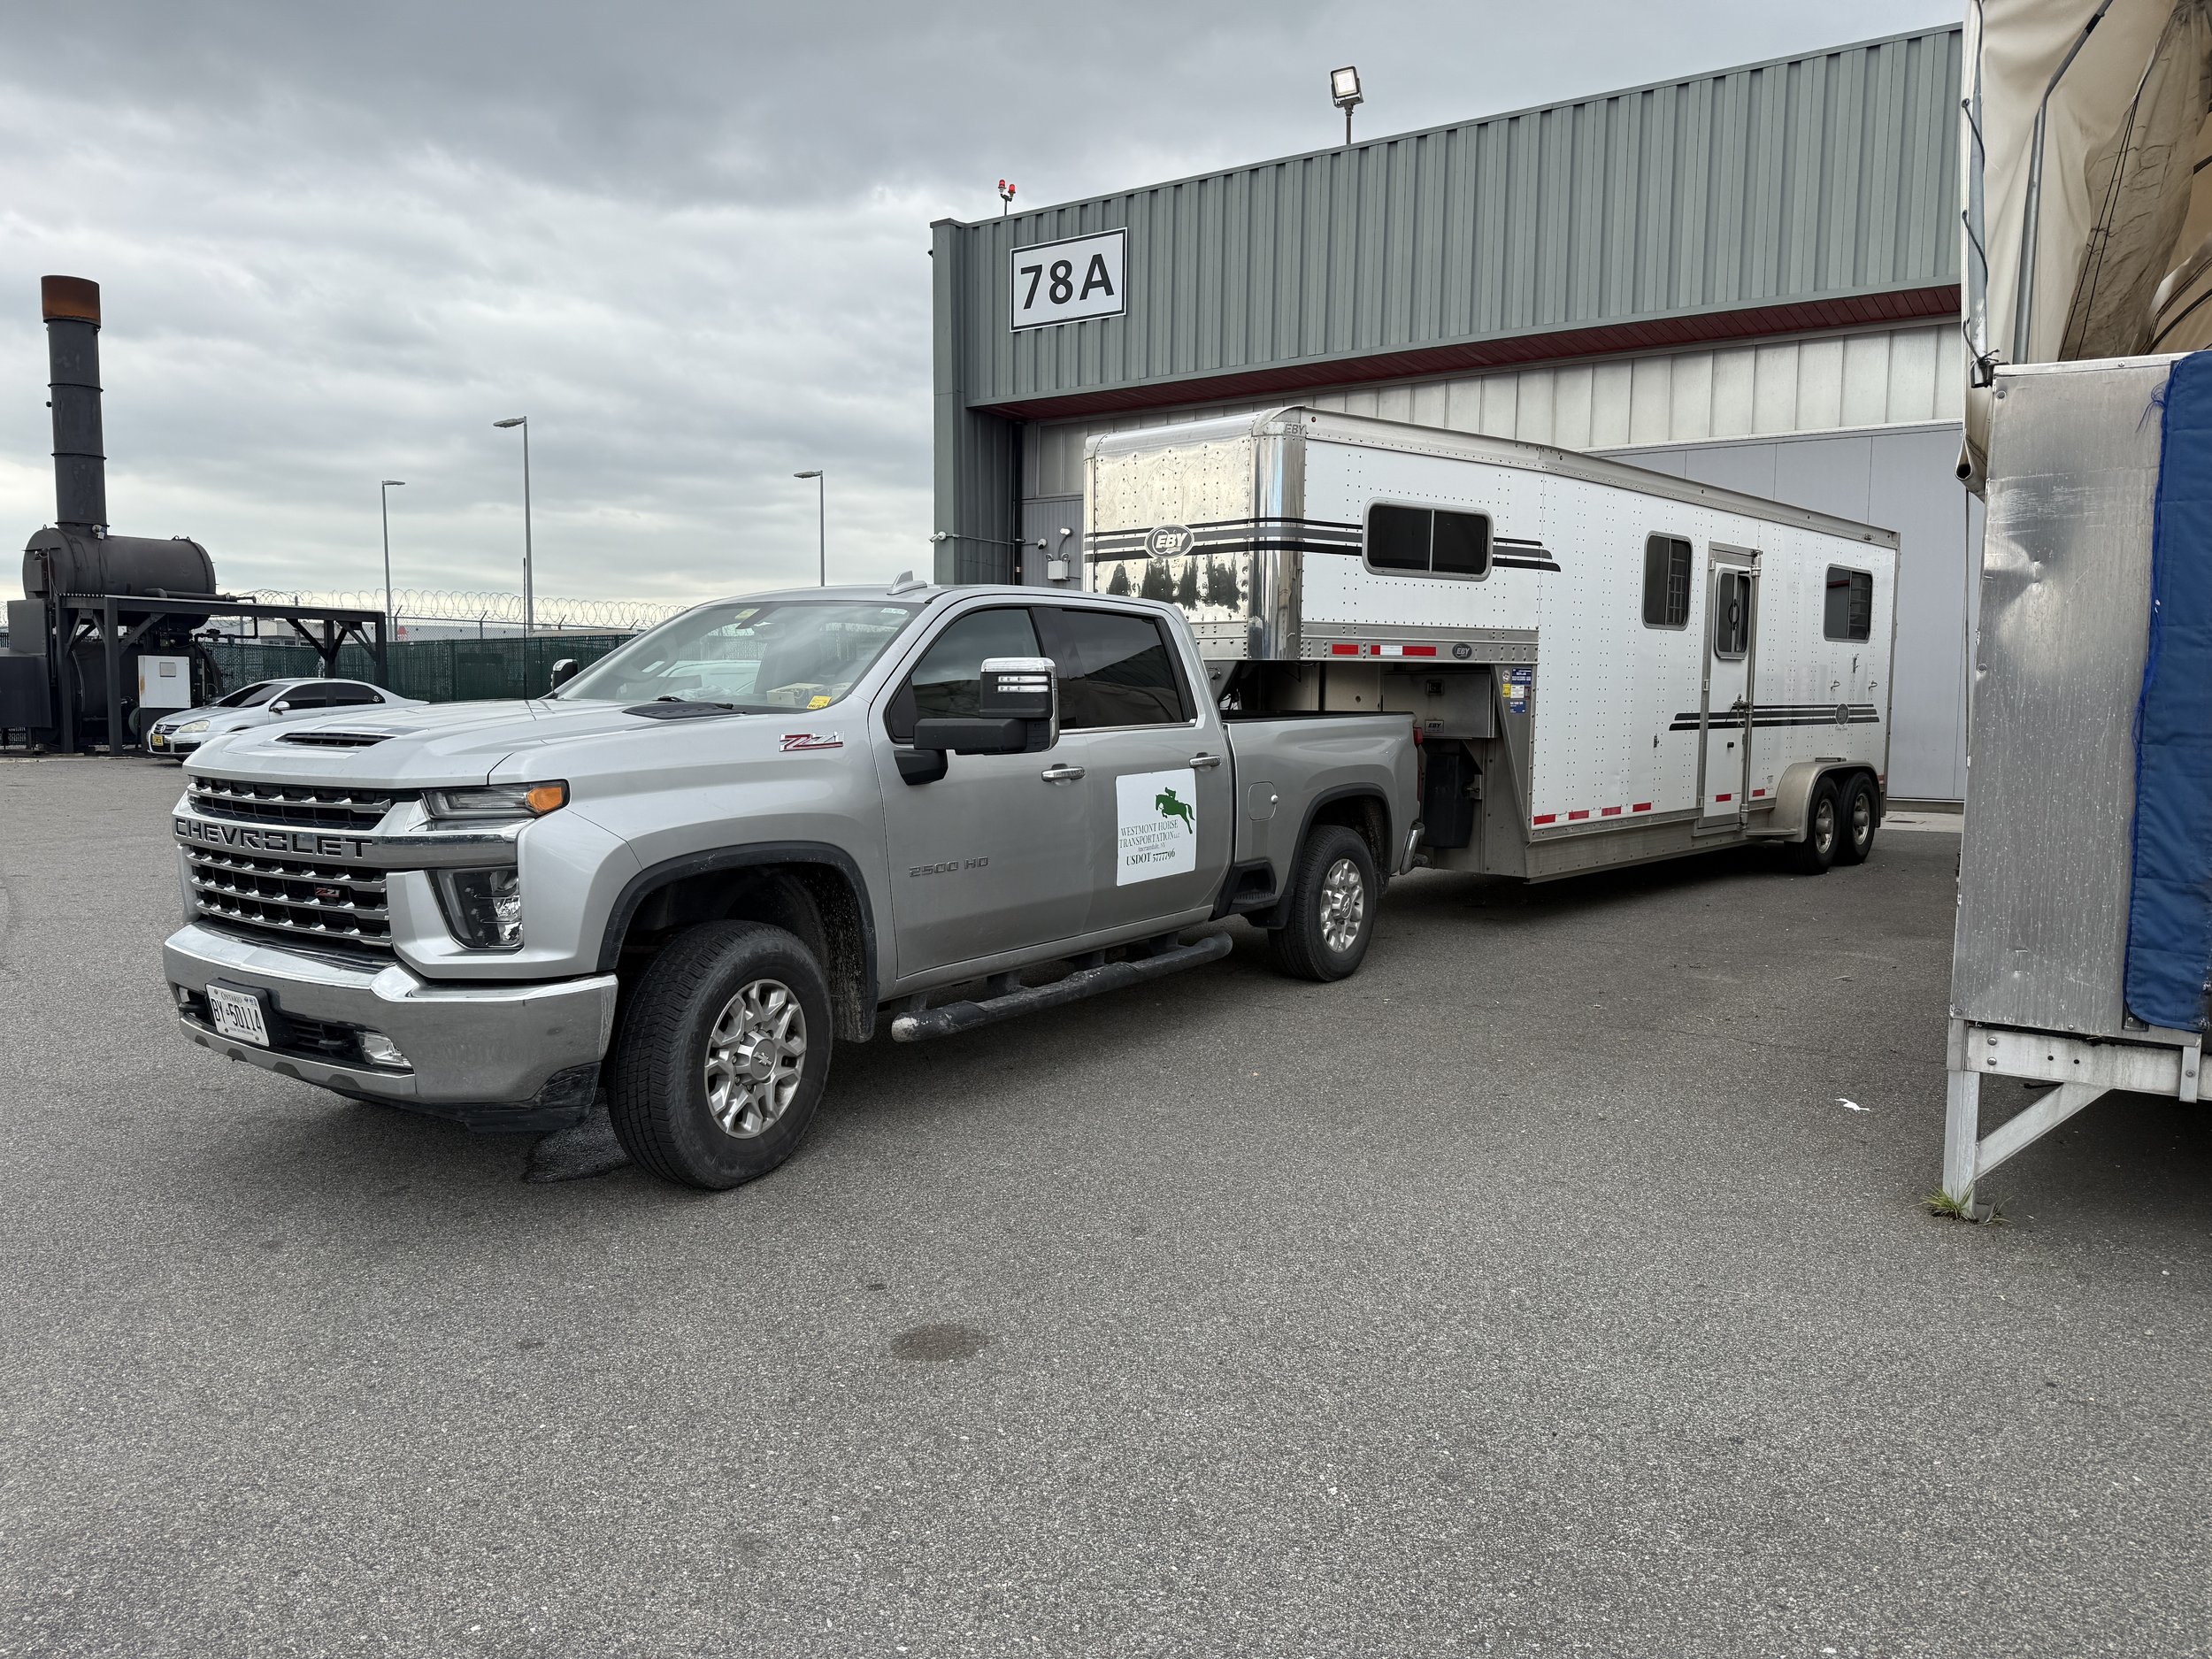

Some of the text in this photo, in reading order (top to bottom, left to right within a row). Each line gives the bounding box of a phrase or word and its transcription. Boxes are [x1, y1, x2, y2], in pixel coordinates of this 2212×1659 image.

[1020, 253, 1115, 310] 78A
[1285, 424, 1305, 434] EBY
[1155, 532, 1188, 549] EBY
[1456, 647, 1471, 656] EBY
[1120, 819, 1179, 836] WESTMONT HORSE
[175, 818, 373, 859] CHEVROLET
[1119, 831, 1174, 848] TRANSPORTATION
[909, 856, 988, 877] 2500 HD
[1126, 852, 1151, 865] USDOT
[211, 998, 226, 1024] BY
